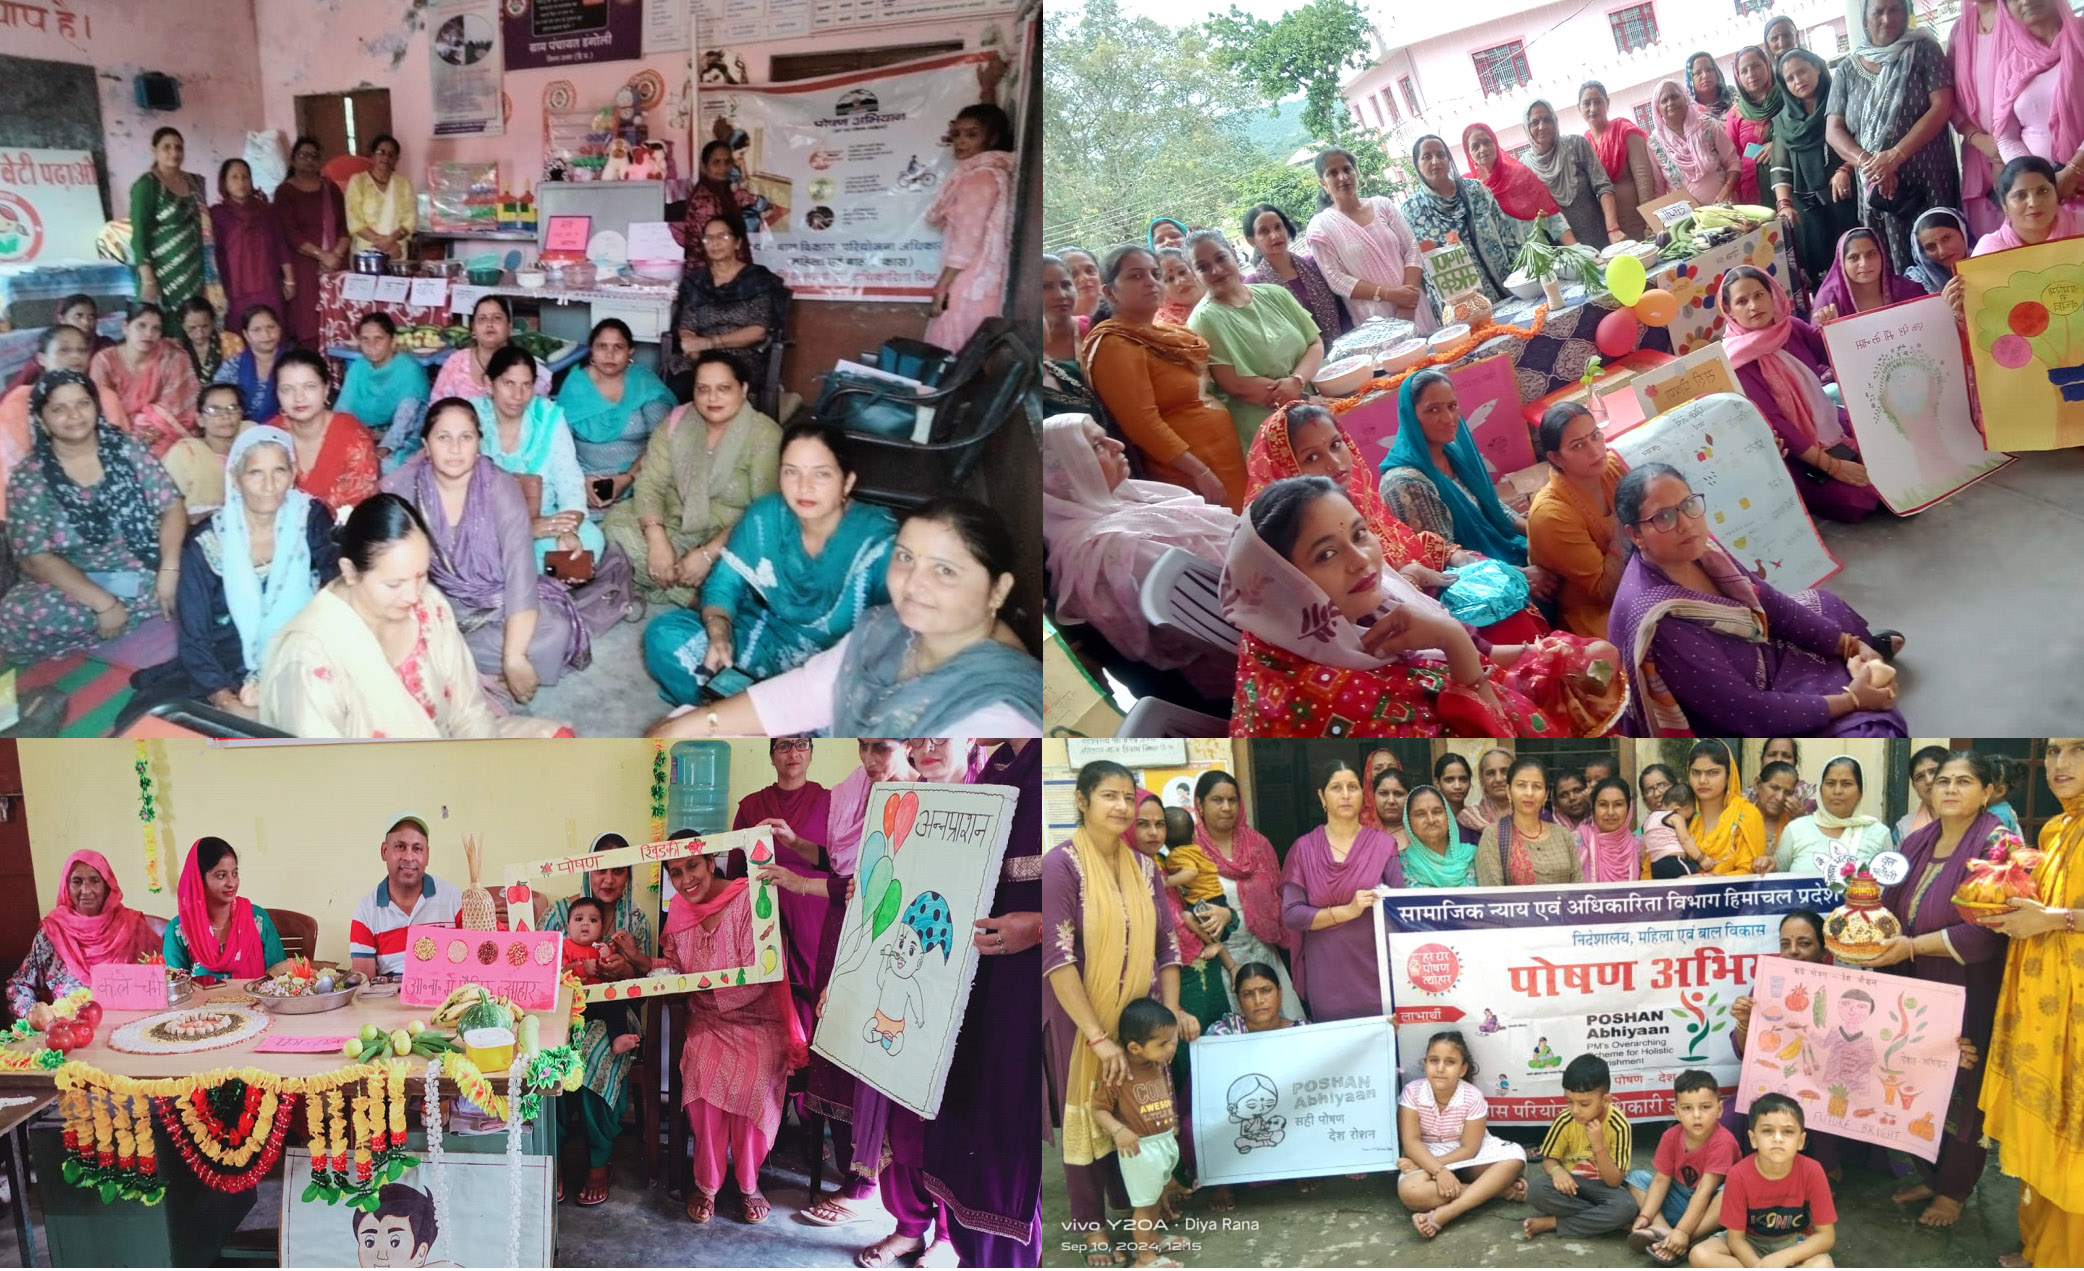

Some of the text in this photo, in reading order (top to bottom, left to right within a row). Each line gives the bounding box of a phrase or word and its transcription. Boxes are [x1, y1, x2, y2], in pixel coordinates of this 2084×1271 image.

[814, 112, 906, 127] पोषण अभियान
[557, 856, 604, 874] पोषण
[1397, 899, 1485, 923] सामाजिक
[1488, 901, 1530, 918] न्याय
[1533, 896, 1562, 921] एवं
[1567, 893, 1662, 916] अधिकारिता
[1666, 890, 1720, 912] विभाग
[1724, 884, 1793, 907] हिमाचल
[1572, 922, 1767, 948] निदेशालय, महिला एवं बाल विकास
[1422, 962, 1450, 974] पोषण
[1507, 956, 1639, 997] पोषण
[1400, 1007, 1442, 1022] लाभार्थी
[1586, 1010, 1664, 1026] POSHAN
[1586, 1025, 1670, 1039] Abhiyaan
[1586, 1039, 1667, 1050] PM's Overarching
[1641, 1047, 1674, 1055] Holistic
[1292, 1075, 1370, 1095] POSHAN
[1614, 1073, 1644, 1085] पोषण
[1294, 1088, 1377, 1109] Abhiyaan
[1294, 1111, 1345, 1127] सही पोषण
[1327, 1126, 1377, 1142] देश रोशन
